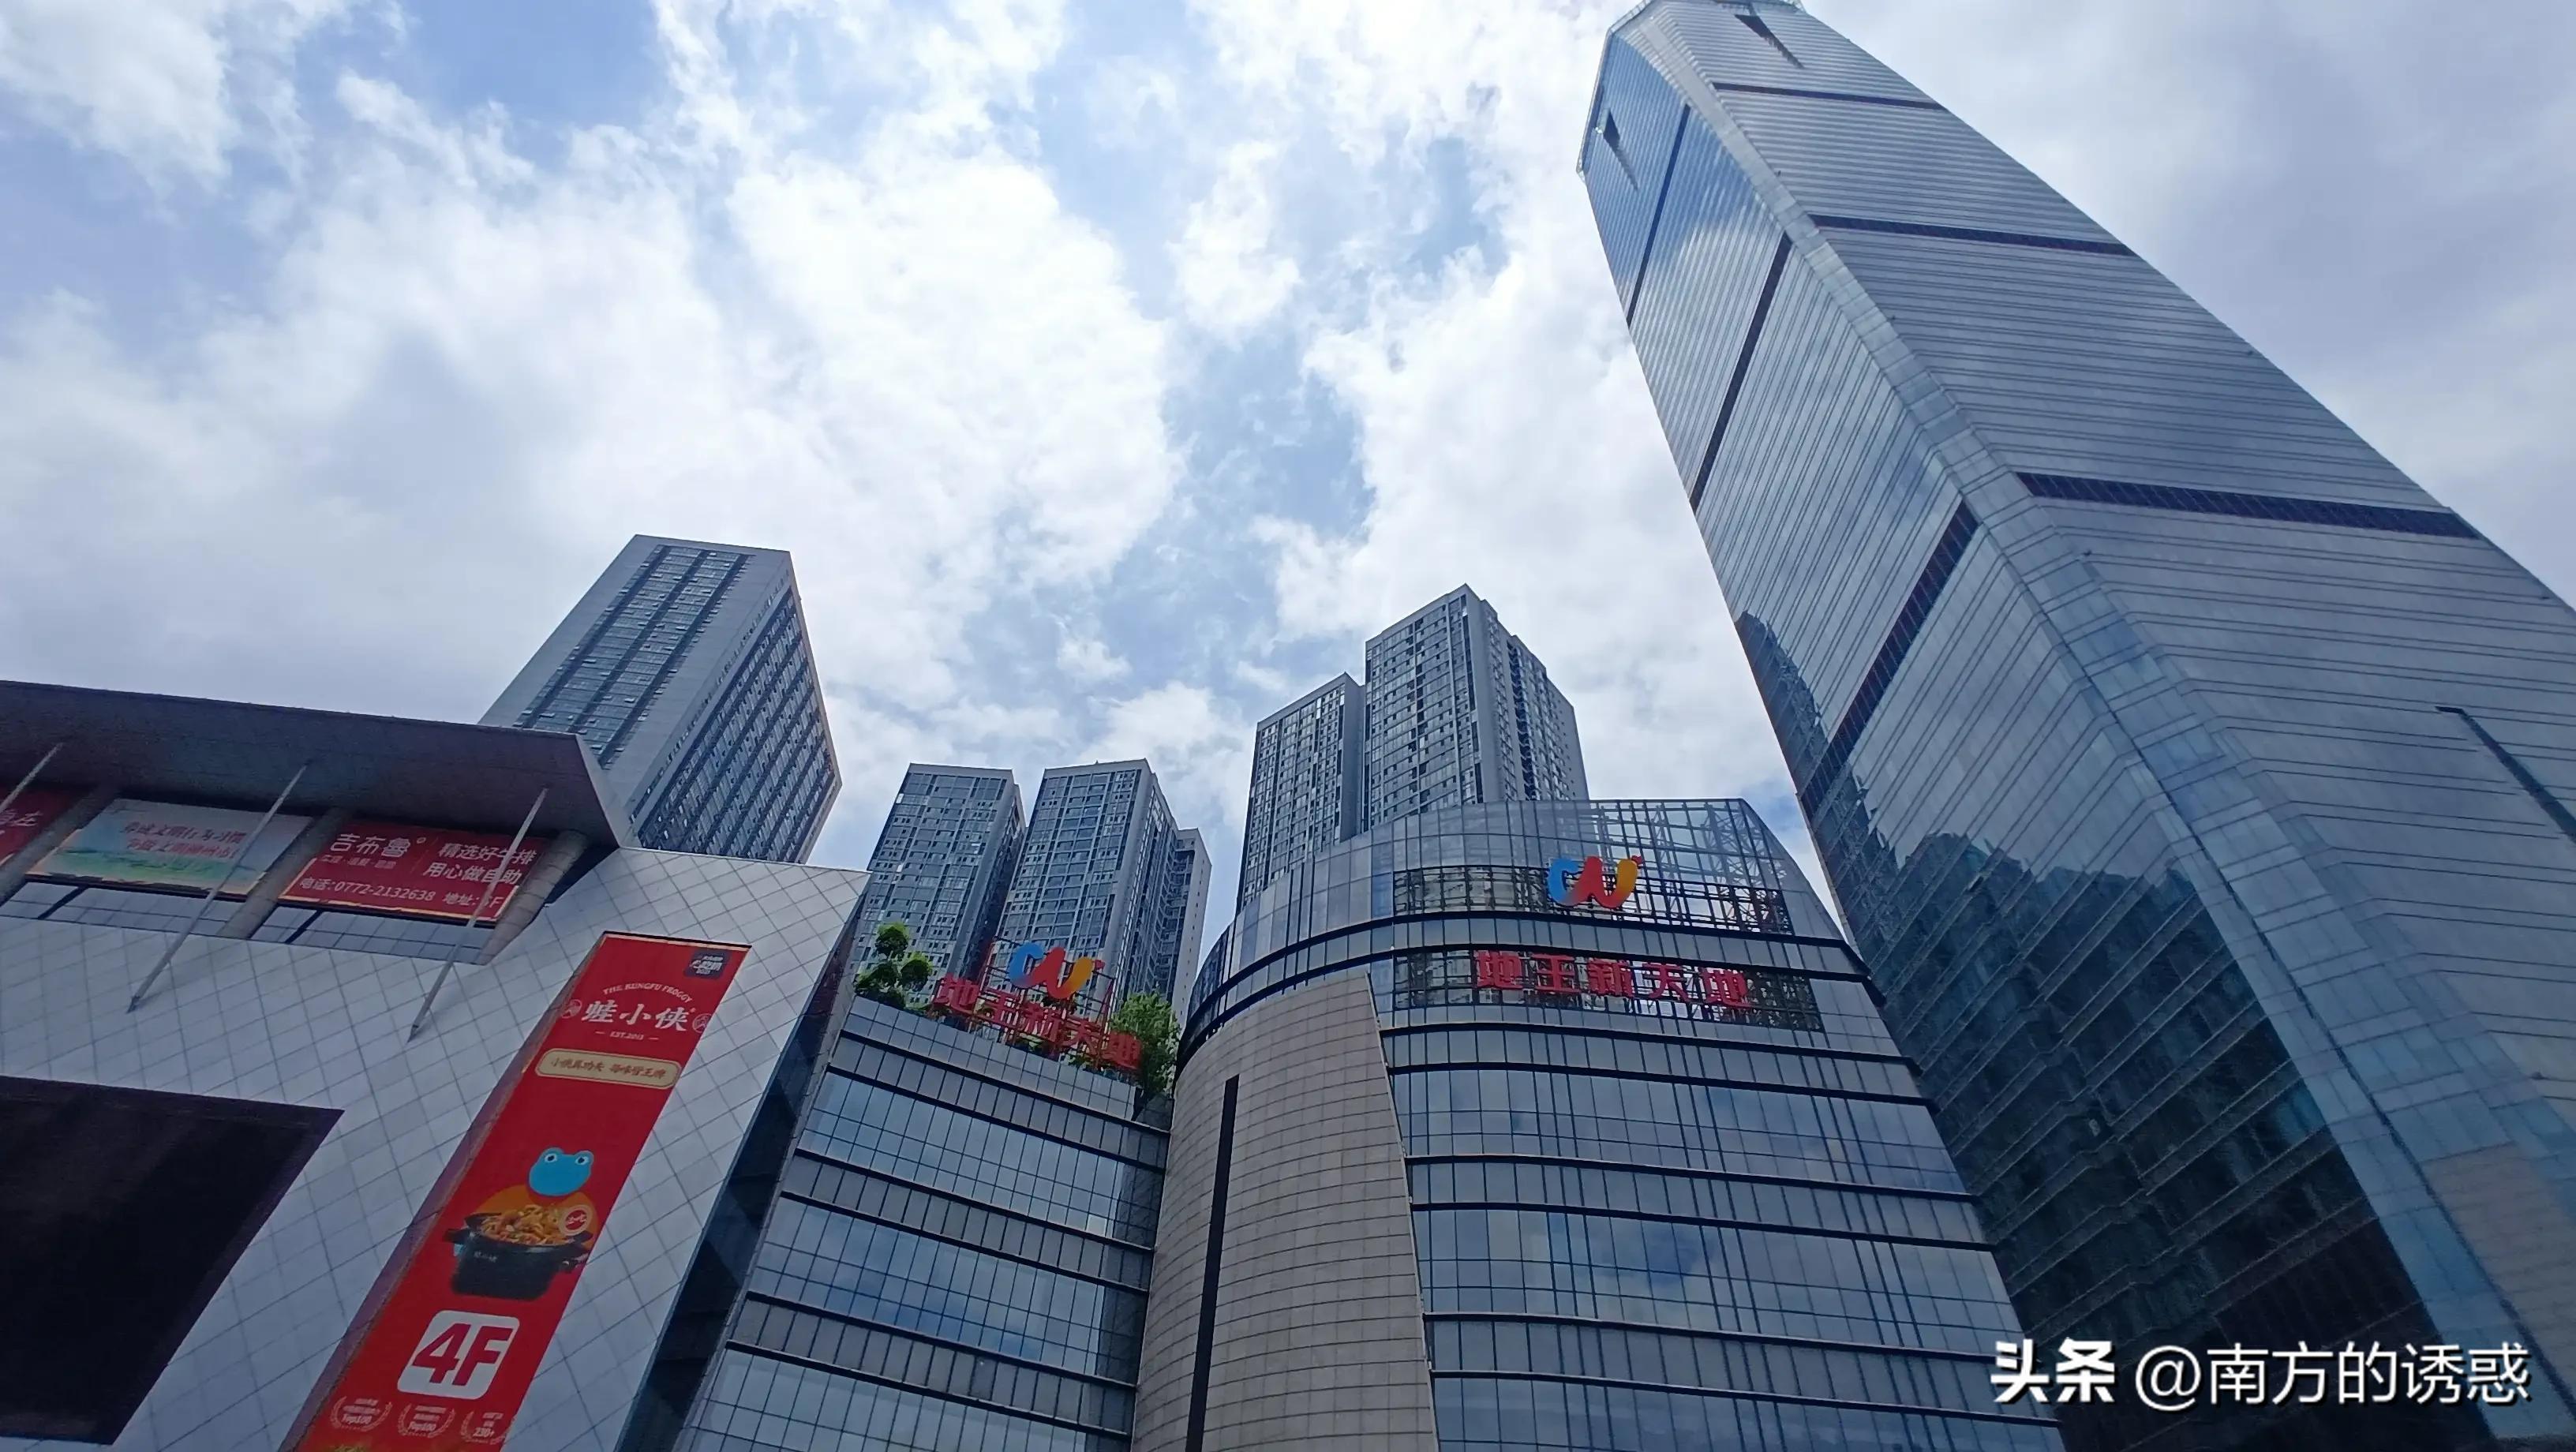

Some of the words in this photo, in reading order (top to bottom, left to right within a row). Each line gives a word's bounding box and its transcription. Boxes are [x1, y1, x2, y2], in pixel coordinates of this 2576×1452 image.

[330, 833, 411, 858] 吉布鲁
[437, 842, 537, 866] 精选好牛排
[422, 861, 522, 885] 用心做自助
[1474, 949, 1753, 1012] 地王新天地
[580, 999, 690, 1031] 蛙小侠
[412, 1323, 514, 1387] 4F
